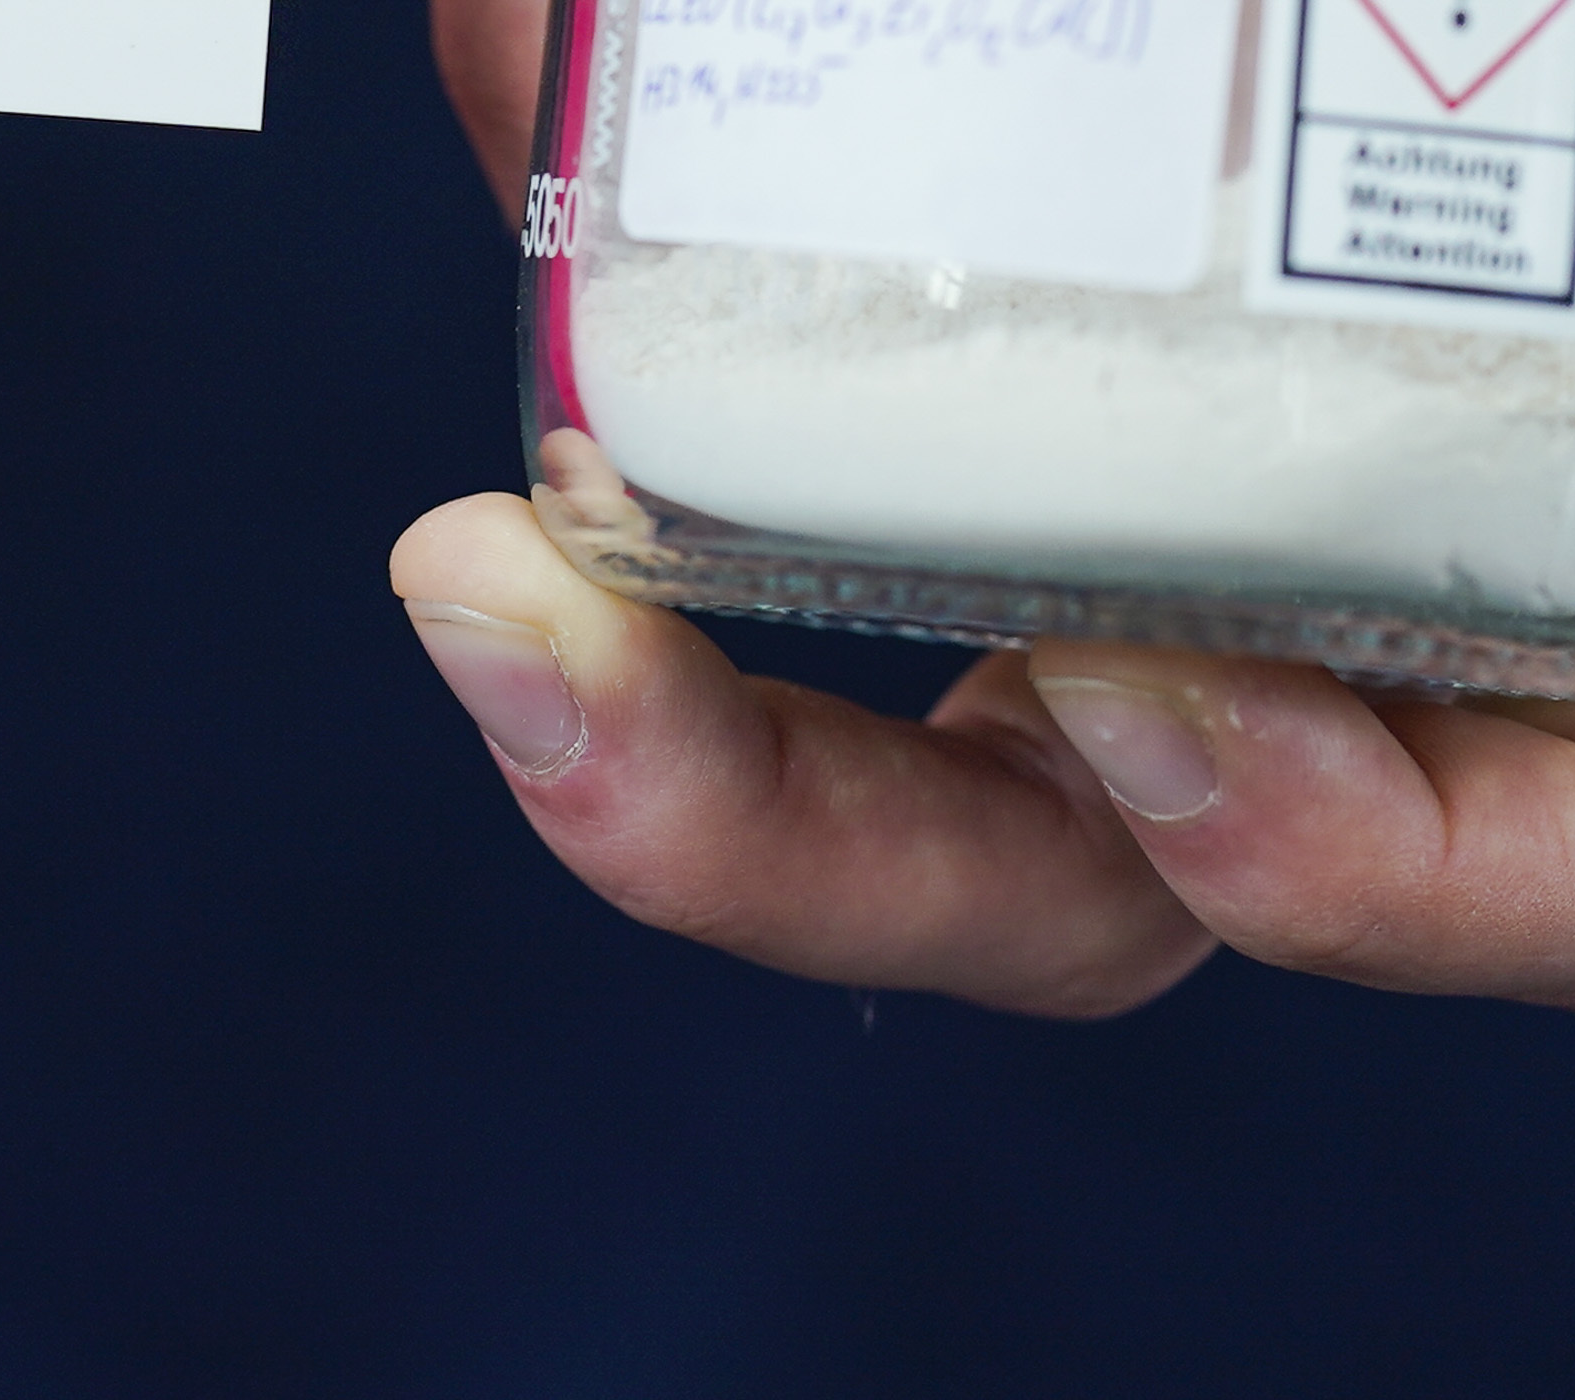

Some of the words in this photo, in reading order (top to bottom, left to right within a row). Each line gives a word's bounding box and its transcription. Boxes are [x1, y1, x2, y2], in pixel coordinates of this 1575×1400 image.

[1347, 140, 1523, 191] Achtung
[1346, 183, 1512, 235] Warning
[1343, 230, 1529, 275] Attention
